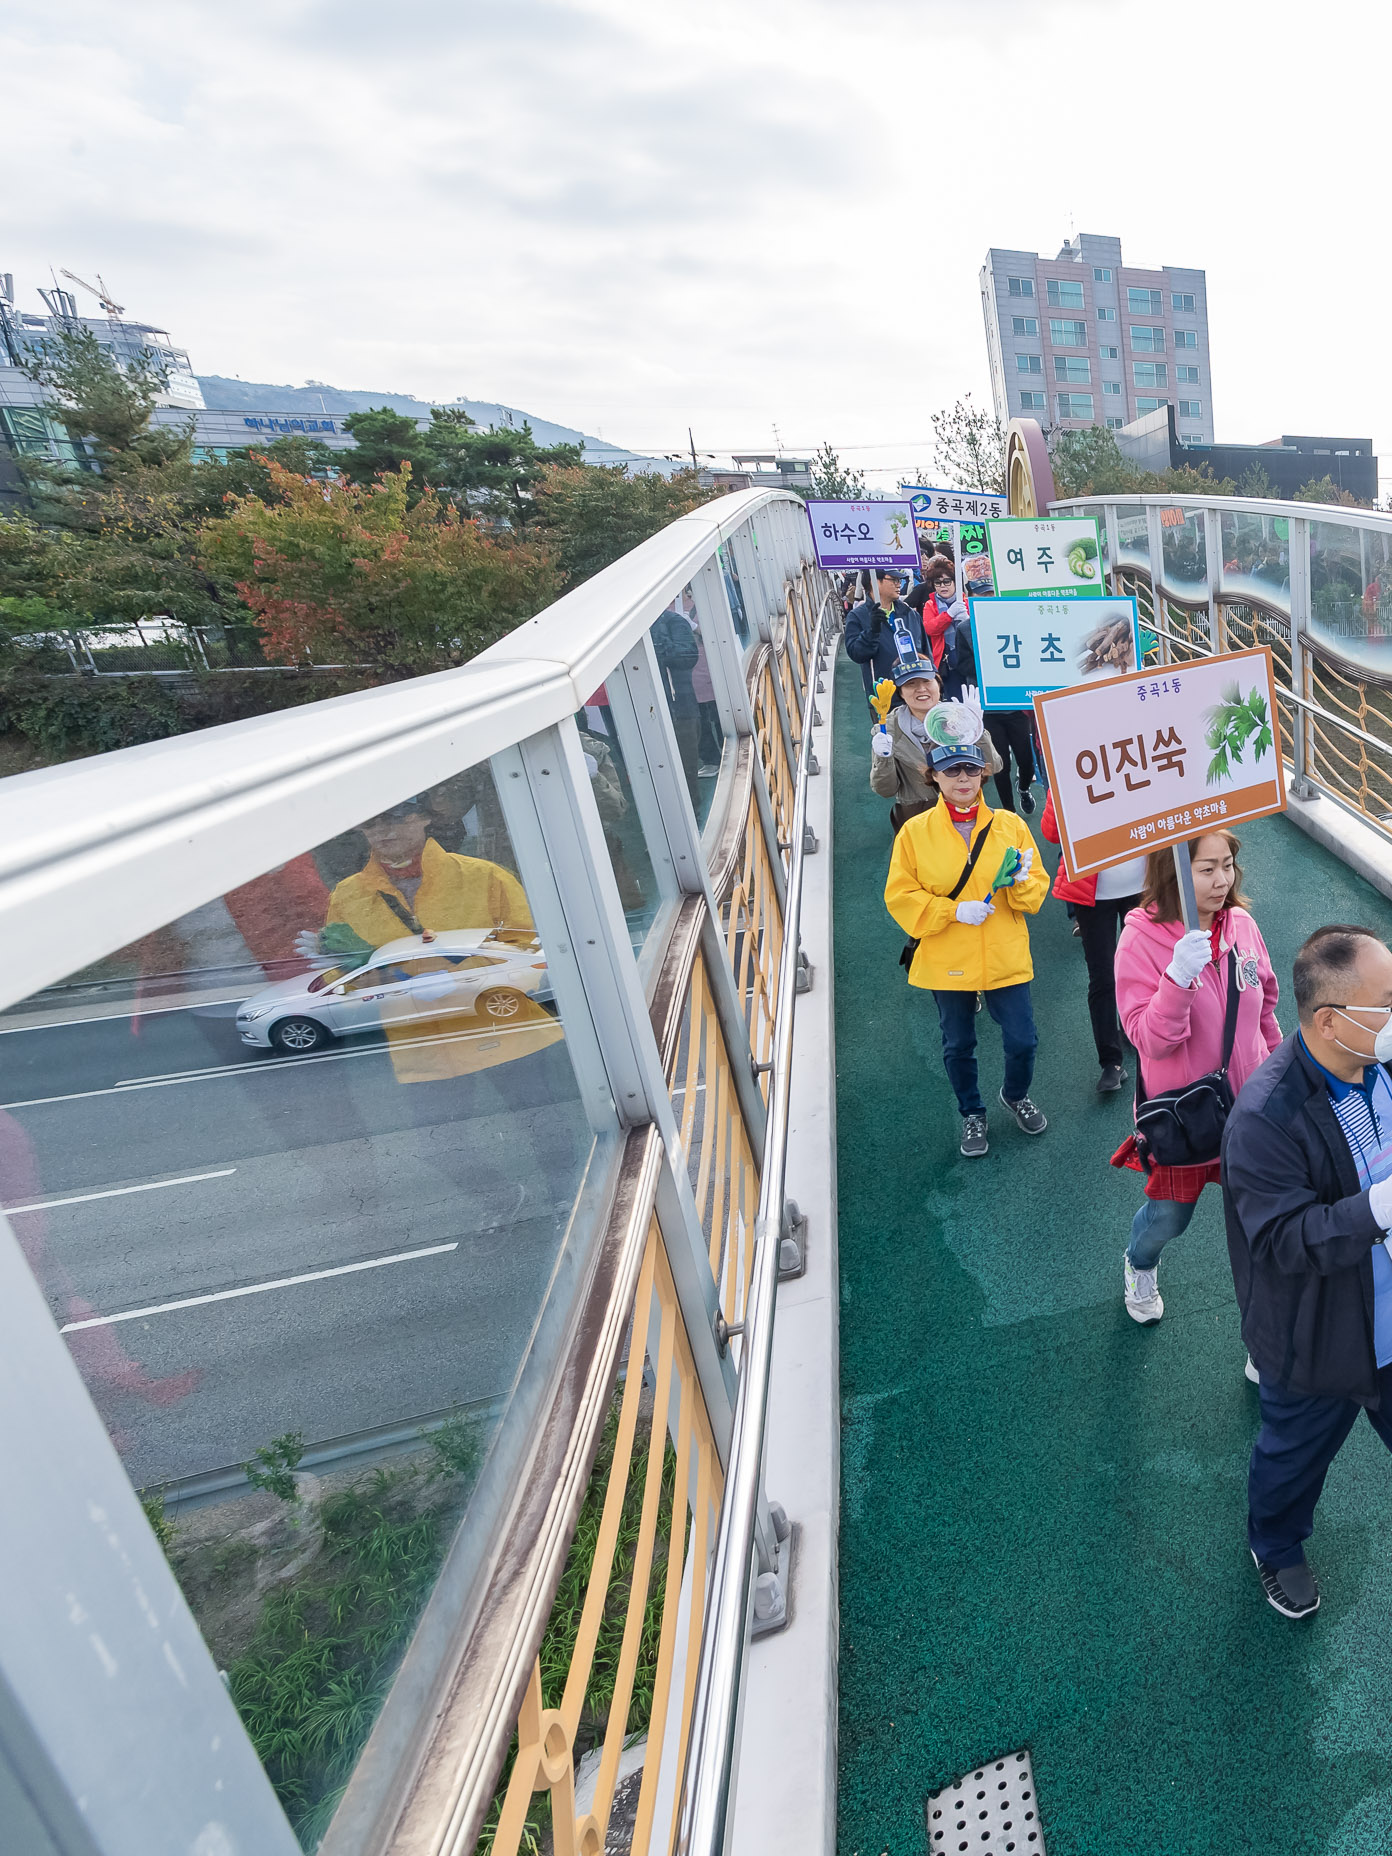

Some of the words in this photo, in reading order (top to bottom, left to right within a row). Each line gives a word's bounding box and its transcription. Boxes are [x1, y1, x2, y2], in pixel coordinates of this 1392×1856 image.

[935, 497, 1002, 519] 중곡제2동
[820, 522, 875, 544] 하수오
[1033, 523, 1056, 532] 중곡1동
[1037, 604, 1069, 615] 중곡1동
[1136, 677, 1182, 702] 중곡1동
[1075, 726, 1187, 804] 인진쑥
[1129, 822, 1156, 840] 사람이
[1157, 811, 1192, 832] 아름다운
[1193, 799, 1228, 821] 약초마을
